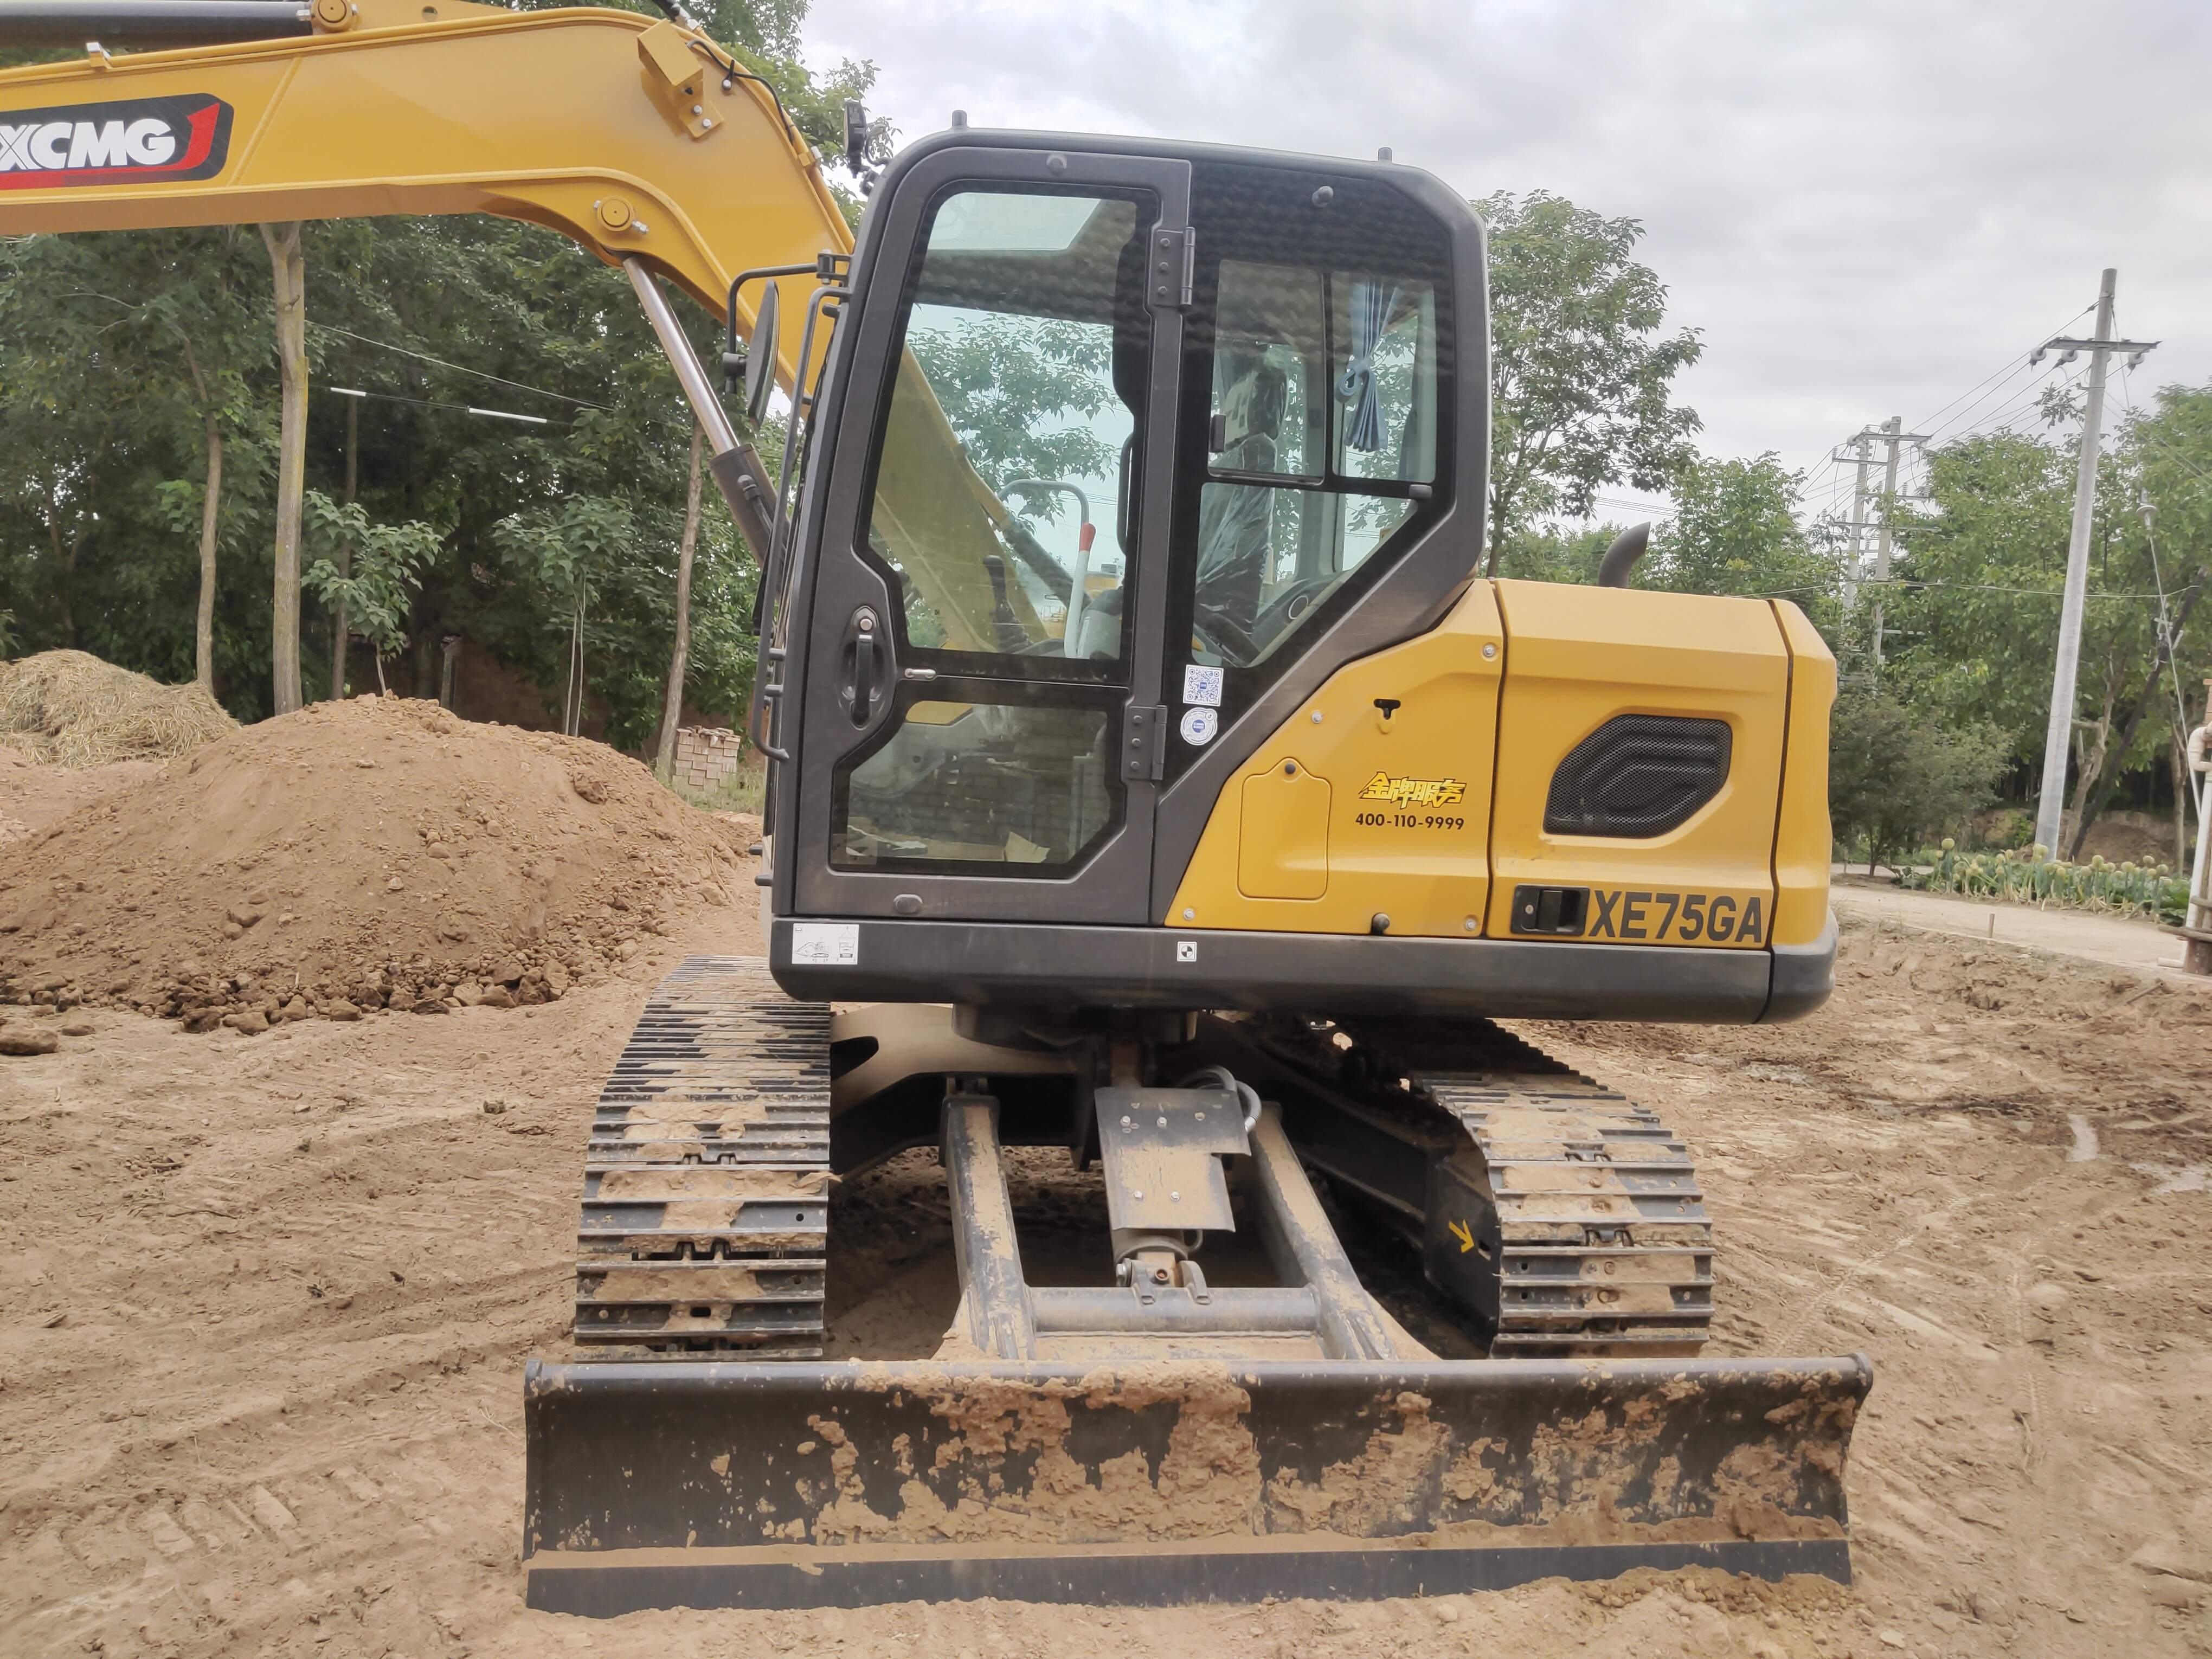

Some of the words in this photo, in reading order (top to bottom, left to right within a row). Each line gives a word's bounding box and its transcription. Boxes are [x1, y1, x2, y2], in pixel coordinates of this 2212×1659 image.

[1358, 771, 1467, 809] 金牌服务
[1355, 813, 1464, 829] 400-110-9999
[1588, 890, 1762, 943] XE75GA
